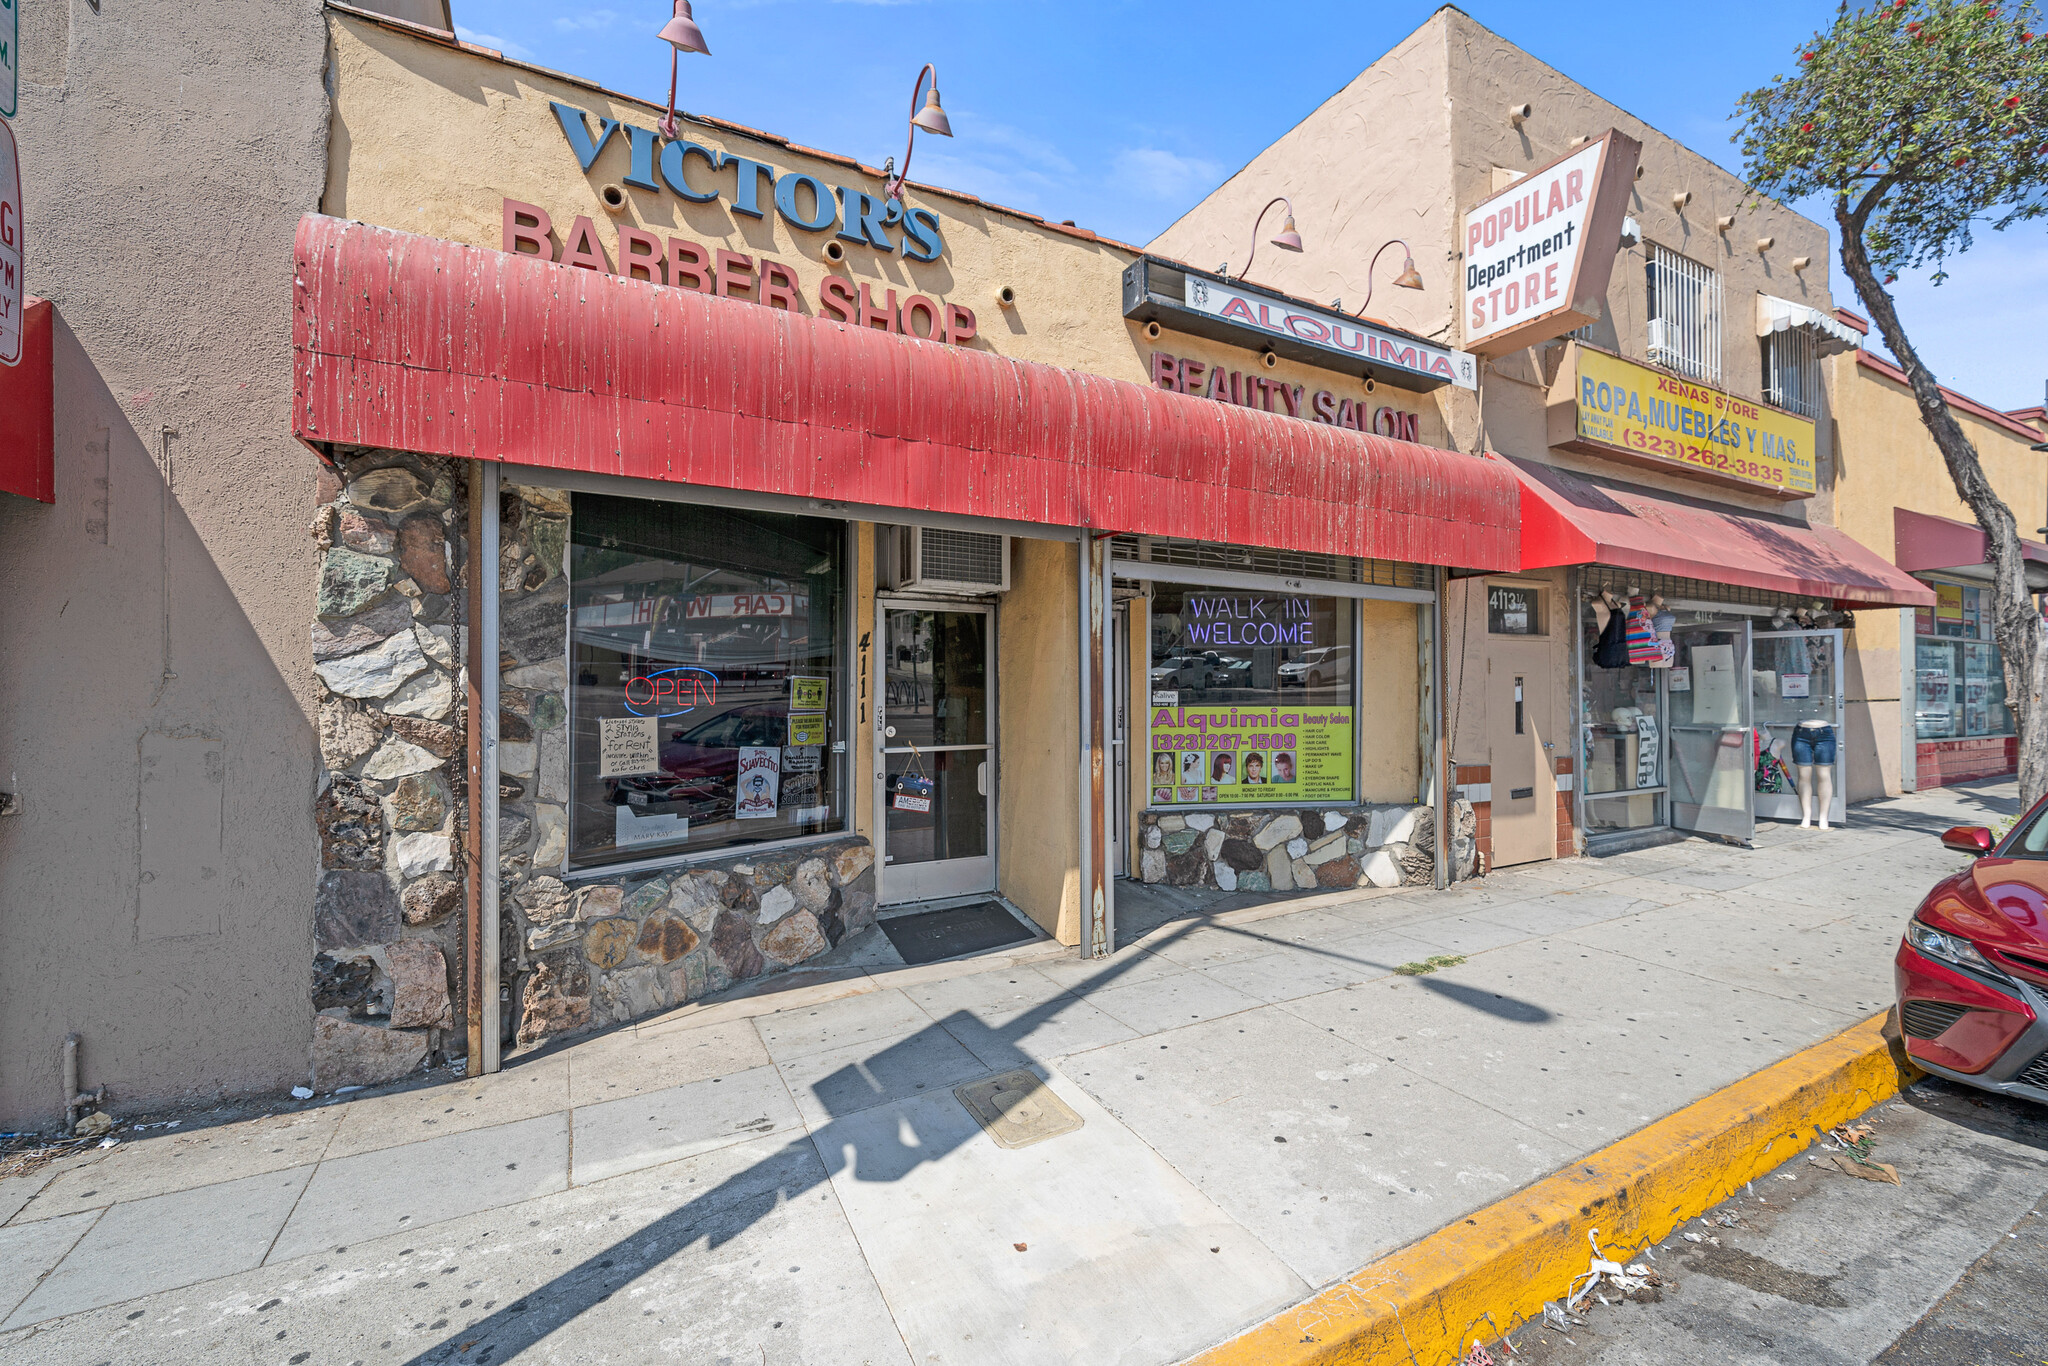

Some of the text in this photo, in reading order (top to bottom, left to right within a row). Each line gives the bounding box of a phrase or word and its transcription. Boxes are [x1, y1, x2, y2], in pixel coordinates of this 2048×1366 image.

[549, 101, 940, 263] VICTOR'S
[1468, 168, 1584, 257] POPULAR
[502, 198, 977, 345] BARBER SHOP
[1467, 221, 1575, 291] Department
[1472, 262, 1559, 329] STORE
[1219, 297, 1459, 380] ALQUIMIA
[1151, 351, 1419, 444] BEAUTY SALON
[1657, 376, 1759, 421] XENAS STORE
[1582, 424, 1613, 441] AVAILABLE
[1746, 427, 1758, 453] Y
[1762, 431, 1810, 467] MAS...
[1623, 428, 1783, 483] (323)262-3835
[1191, 597, 1310, 619] WALK IN
[1695, 610, 1713, 624] 4113
[1188, 622, 1313, 645] WELCOME
[625, 676, 716, 706] OPEN
[807, 689, 812, 699] 6
[859, 631, 870, 724] 4111
[605, 724, 613, 733] 2
[1151, 708, 1350, 733] Alquimia Beauty Salon
[1153, 733, 1296, 750] (323)267-1509
[1638, 719, 1650, 786] CLUB
[1645, 726, 1657, 776] PRO
[782, 794, 799, 804] SOLD
[633, 832, 654, 840] MARY
